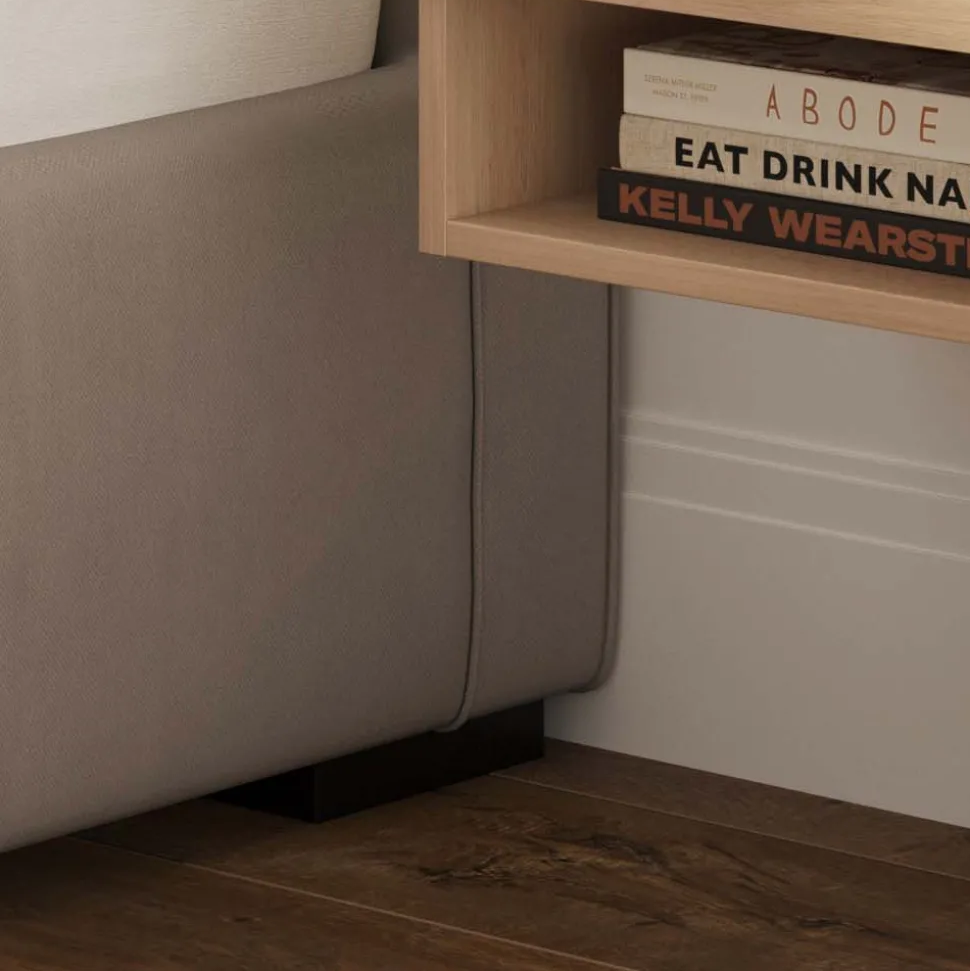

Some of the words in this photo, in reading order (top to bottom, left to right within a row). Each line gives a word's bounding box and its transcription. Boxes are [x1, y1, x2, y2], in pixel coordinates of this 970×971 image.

[766, 83, 939, 144] ABODE
[675, 136, 748, 175] EAT
[763, 150, 893, 198] DRINK
[618, 183, 753, 232] KELLY
